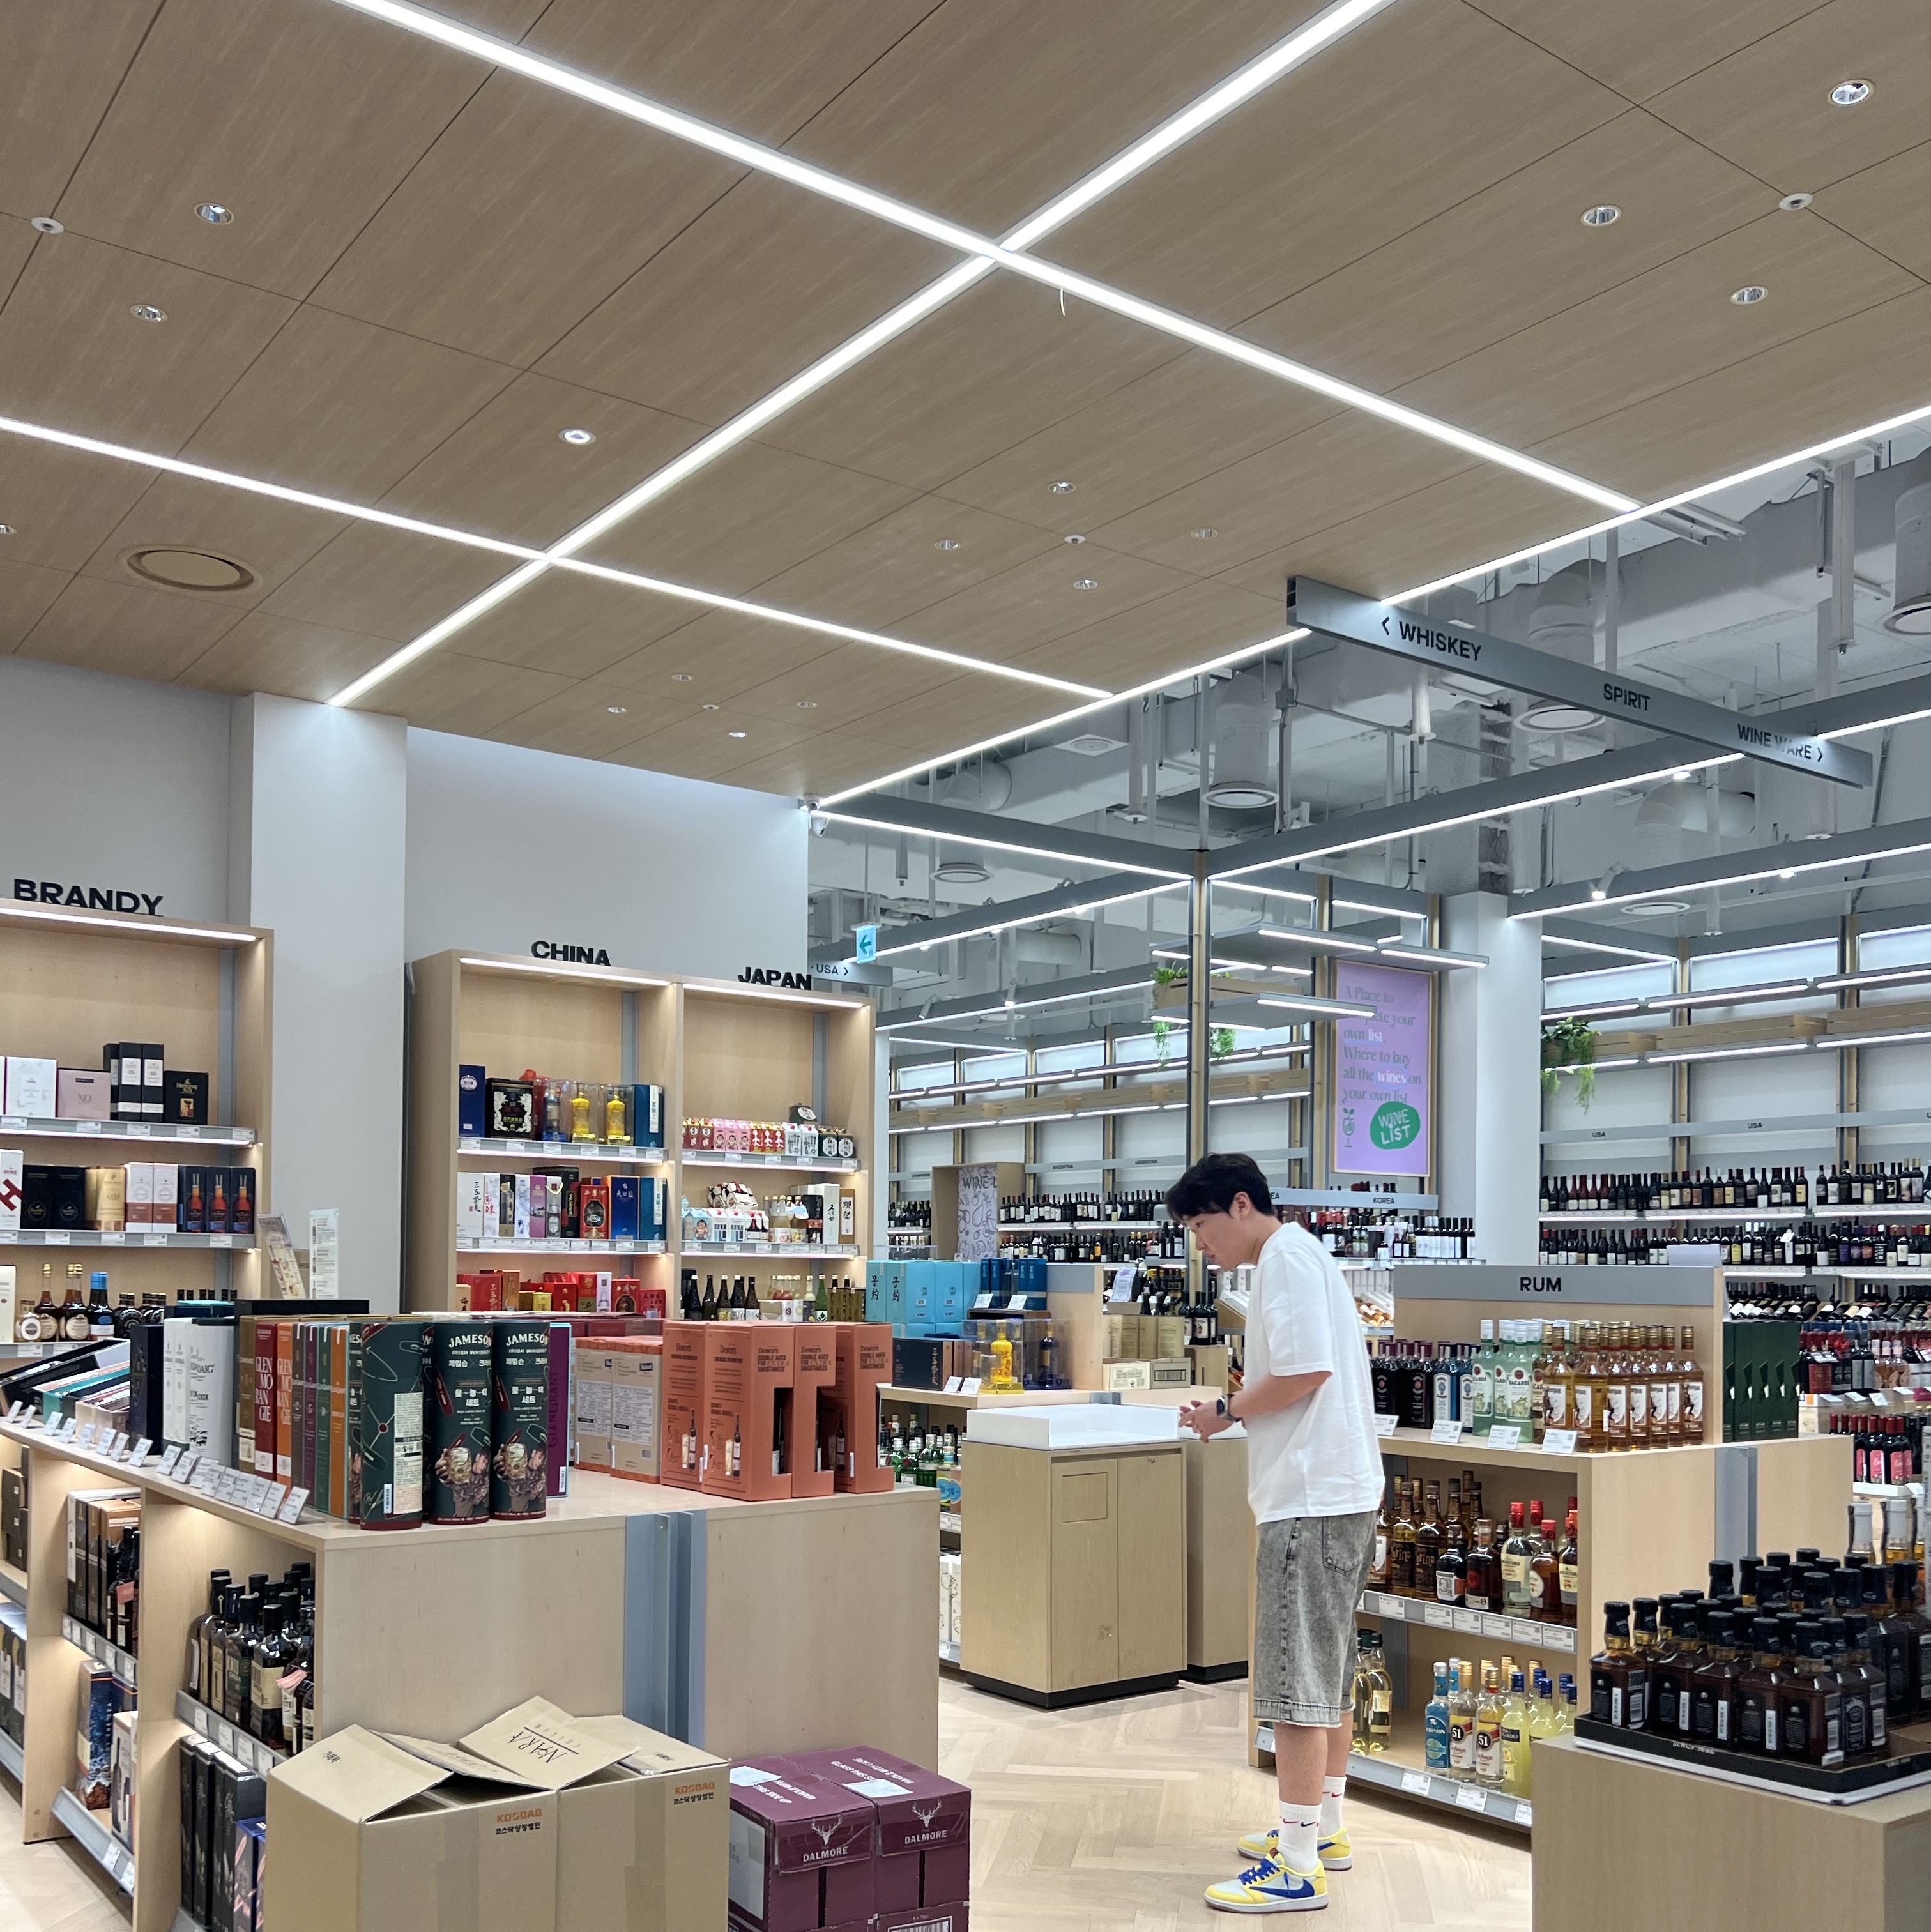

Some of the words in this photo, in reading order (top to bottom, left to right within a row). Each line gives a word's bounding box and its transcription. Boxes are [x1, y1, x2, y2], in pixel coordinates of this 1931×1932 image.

[1399, 620, 1482, 661] WHISKEY
[1603, 683, 1651, 711] SPIRIT
[1737, 723, 1771, 748] WINE
[1775, 736, 1812, 759] WARE
[14, 879, 164, 916] BRANDY
[531, 940, 611, 966] CHINA
[816, 964, 838, 975] USA
[737, 966, 812, 990] JAPAN
[1355, 987, 1380, 1002] Place
[1384, 992, 1394, 1003] to
[1391, 1014, 1415, 1029] your
[1344, 1029, 1365, 1040] own
[1344, 1046, 1377, 1061] Where
[1380, 1051, 1390, 1062] to
[1393, 1051, 1410, 1068] buy
[1343, 1067, 1355, 1079] all
[1359, 1068, 1373, 1081] the
[1377, 1070, 1405, 1083] wines
[1408, 1075, 1421, 1084] on
[1342, 1089, 1367, 1102] your
[1370, 1091, 1390, 1101] own
[1378, 1109, 1410, 1128] WINE
[1380, 1125, 1410, 1145] LIST
[1520, 1277, 1561, 1292] RUM
[256, 1357, 272, 1373] GLEN
[260, 1374, 273, 1389] MO
[256, 1388, 269, 1404] RAN
[259, 1406, 271, 1422] GIE
[535, 1724, 580, 1747] CELLAR
[1451, 1728, 1462, 1739] 51
[1478, 1735, 1489, 1747] 51
[508, 1731, 567, 1763] NARA
[675, 1781, 715, 1795] KOSDAQ
[496, 1809, 542, 1823] KOSDAQ
[904, 1829, 947, 1845] DALMORE
[803, 1846, 848, 1862] DALMORE
